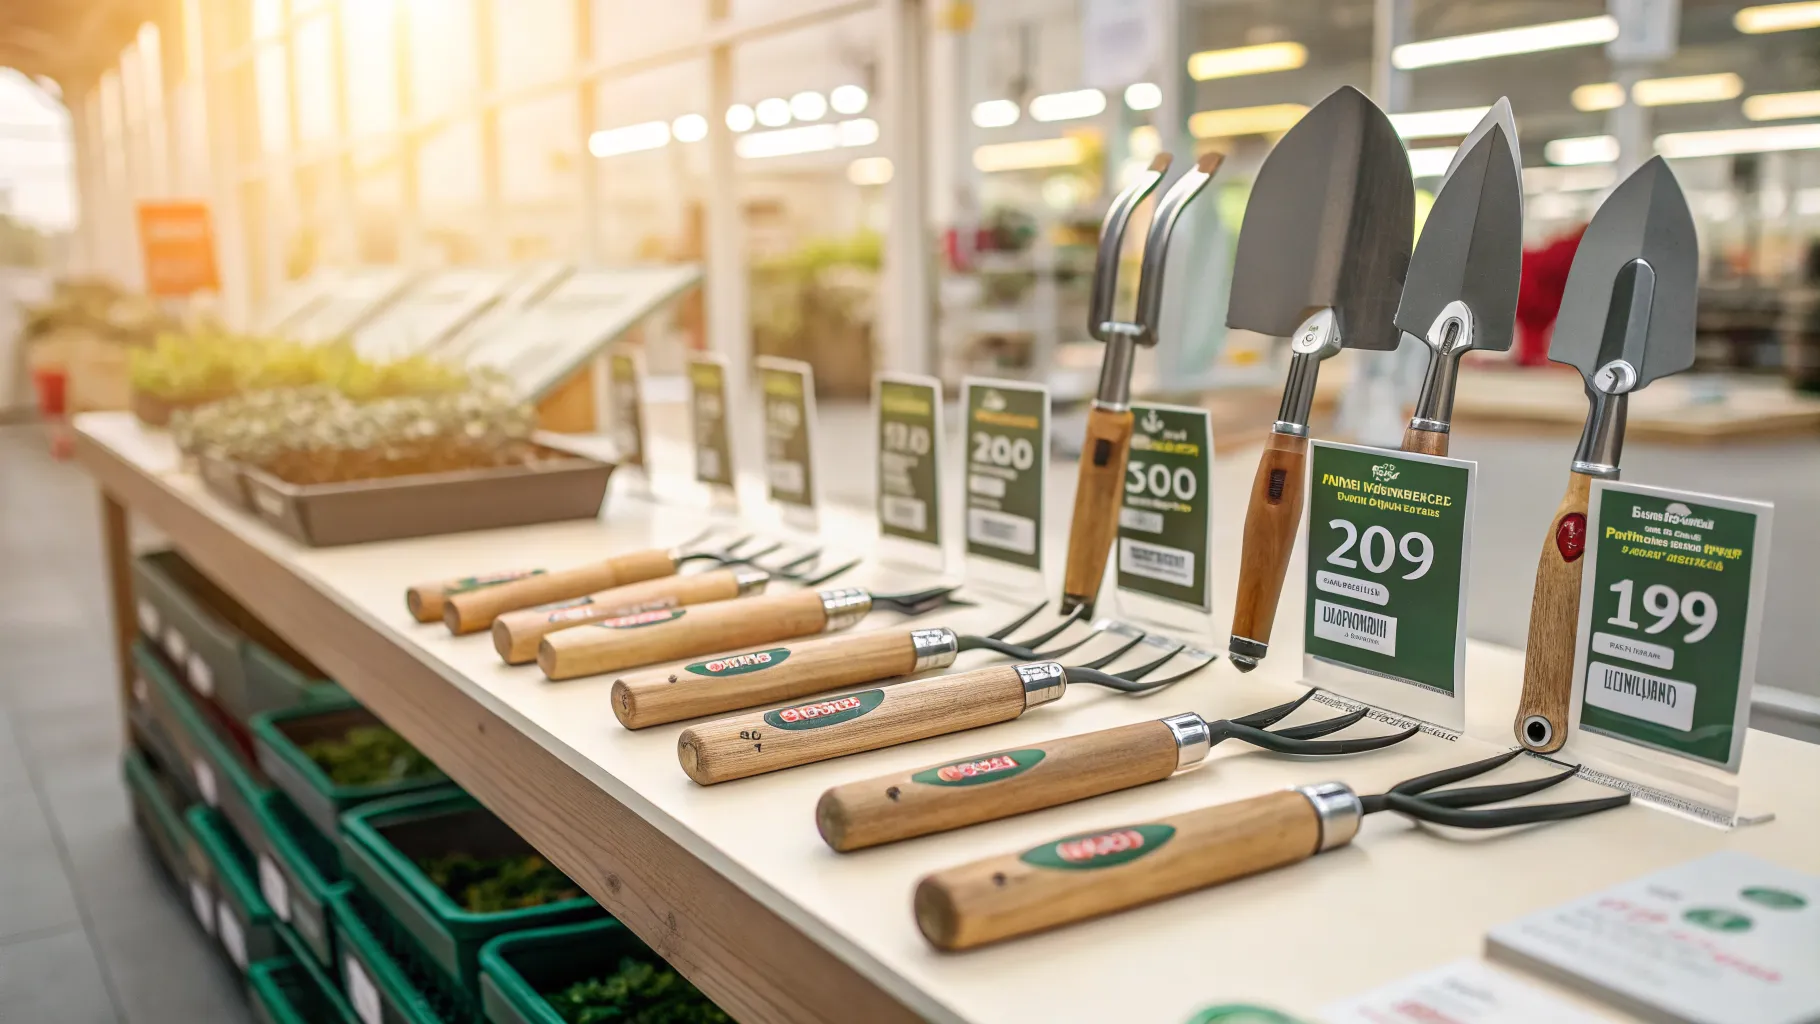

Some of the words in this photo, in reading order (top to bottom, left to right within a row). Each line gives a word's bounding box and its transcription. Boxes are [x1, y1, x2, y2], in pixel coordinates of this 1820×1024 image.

[972, 431, 1034, 470] 200
[1326, 518, 1434, 580] 209
[1607, 578, 1718, 644] 199
